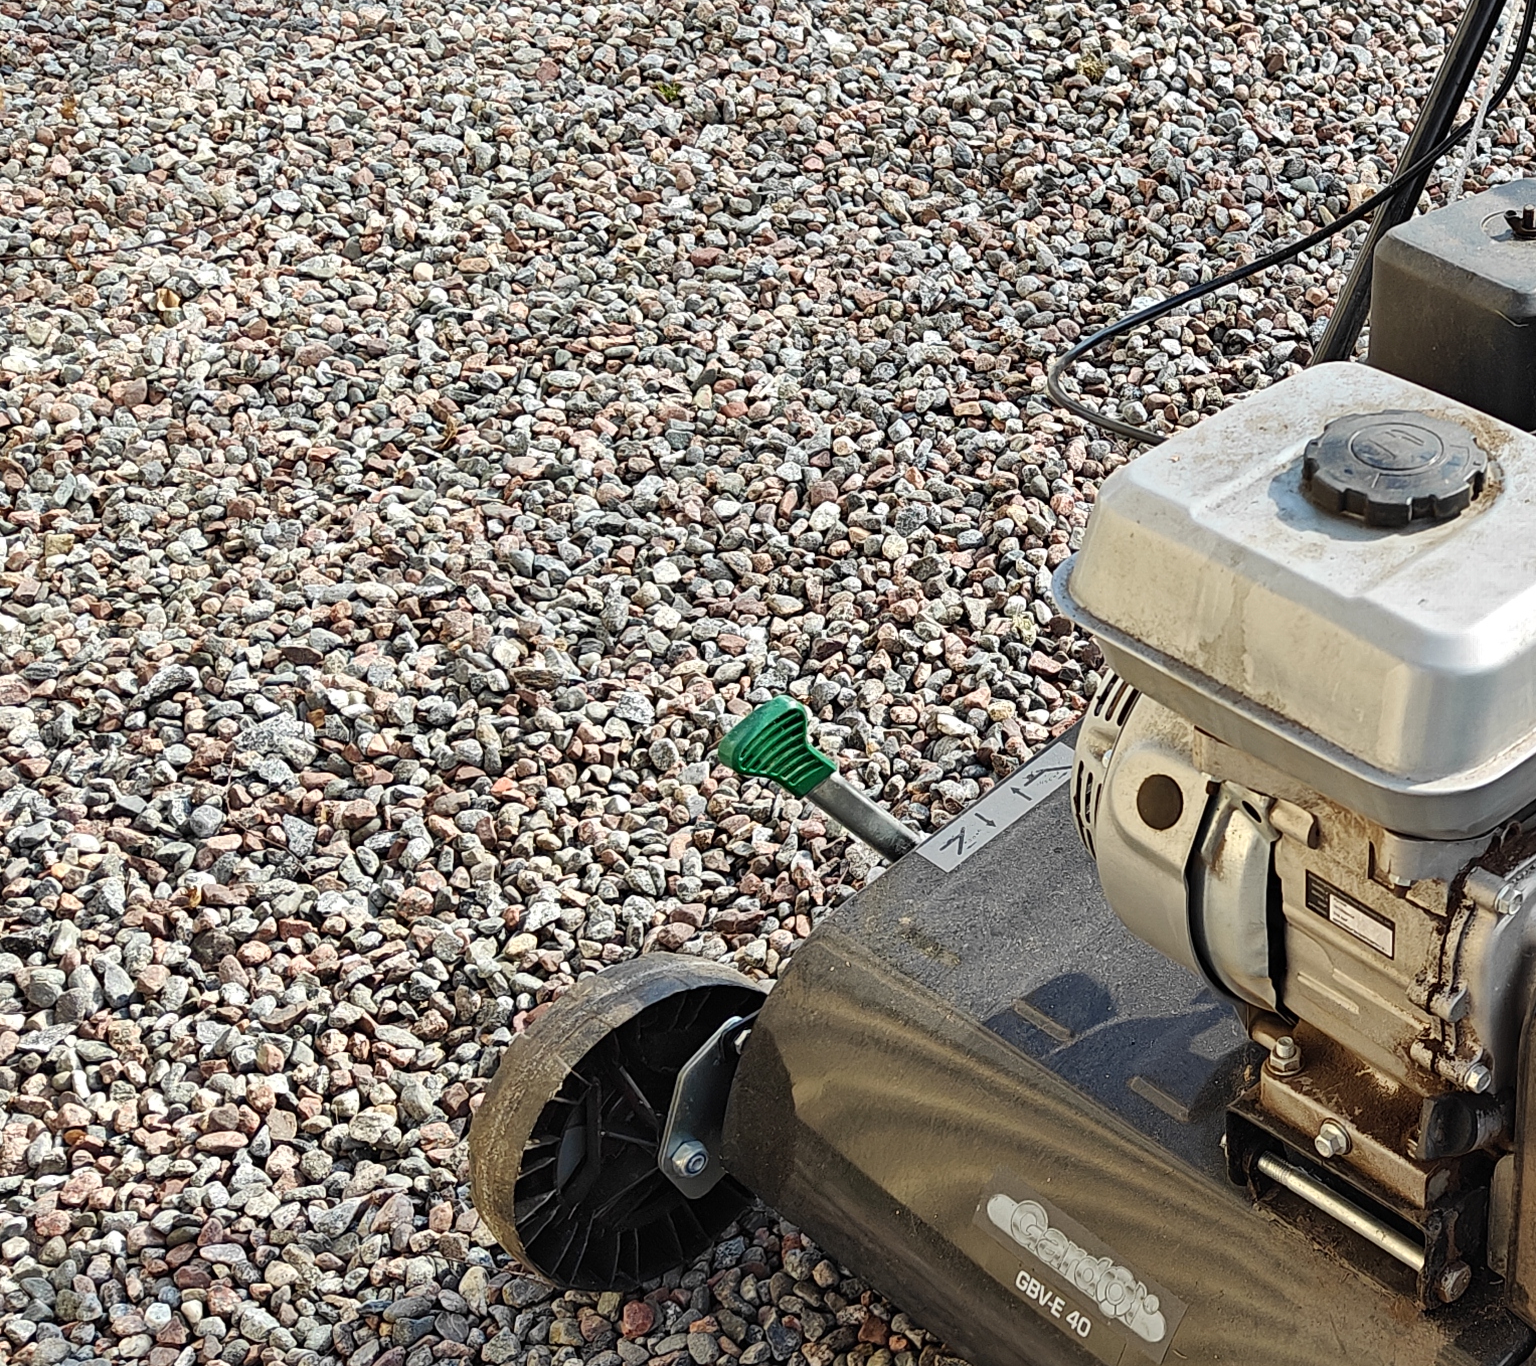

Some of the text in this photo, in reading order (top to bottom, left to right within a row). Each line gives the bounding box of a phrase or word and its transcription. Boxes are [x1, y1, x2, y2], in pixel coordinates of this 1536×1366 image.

[1011, 1200, 1147, 1326] Gardol
[1015, 1270, 1092, 1338] GBV-E 40
